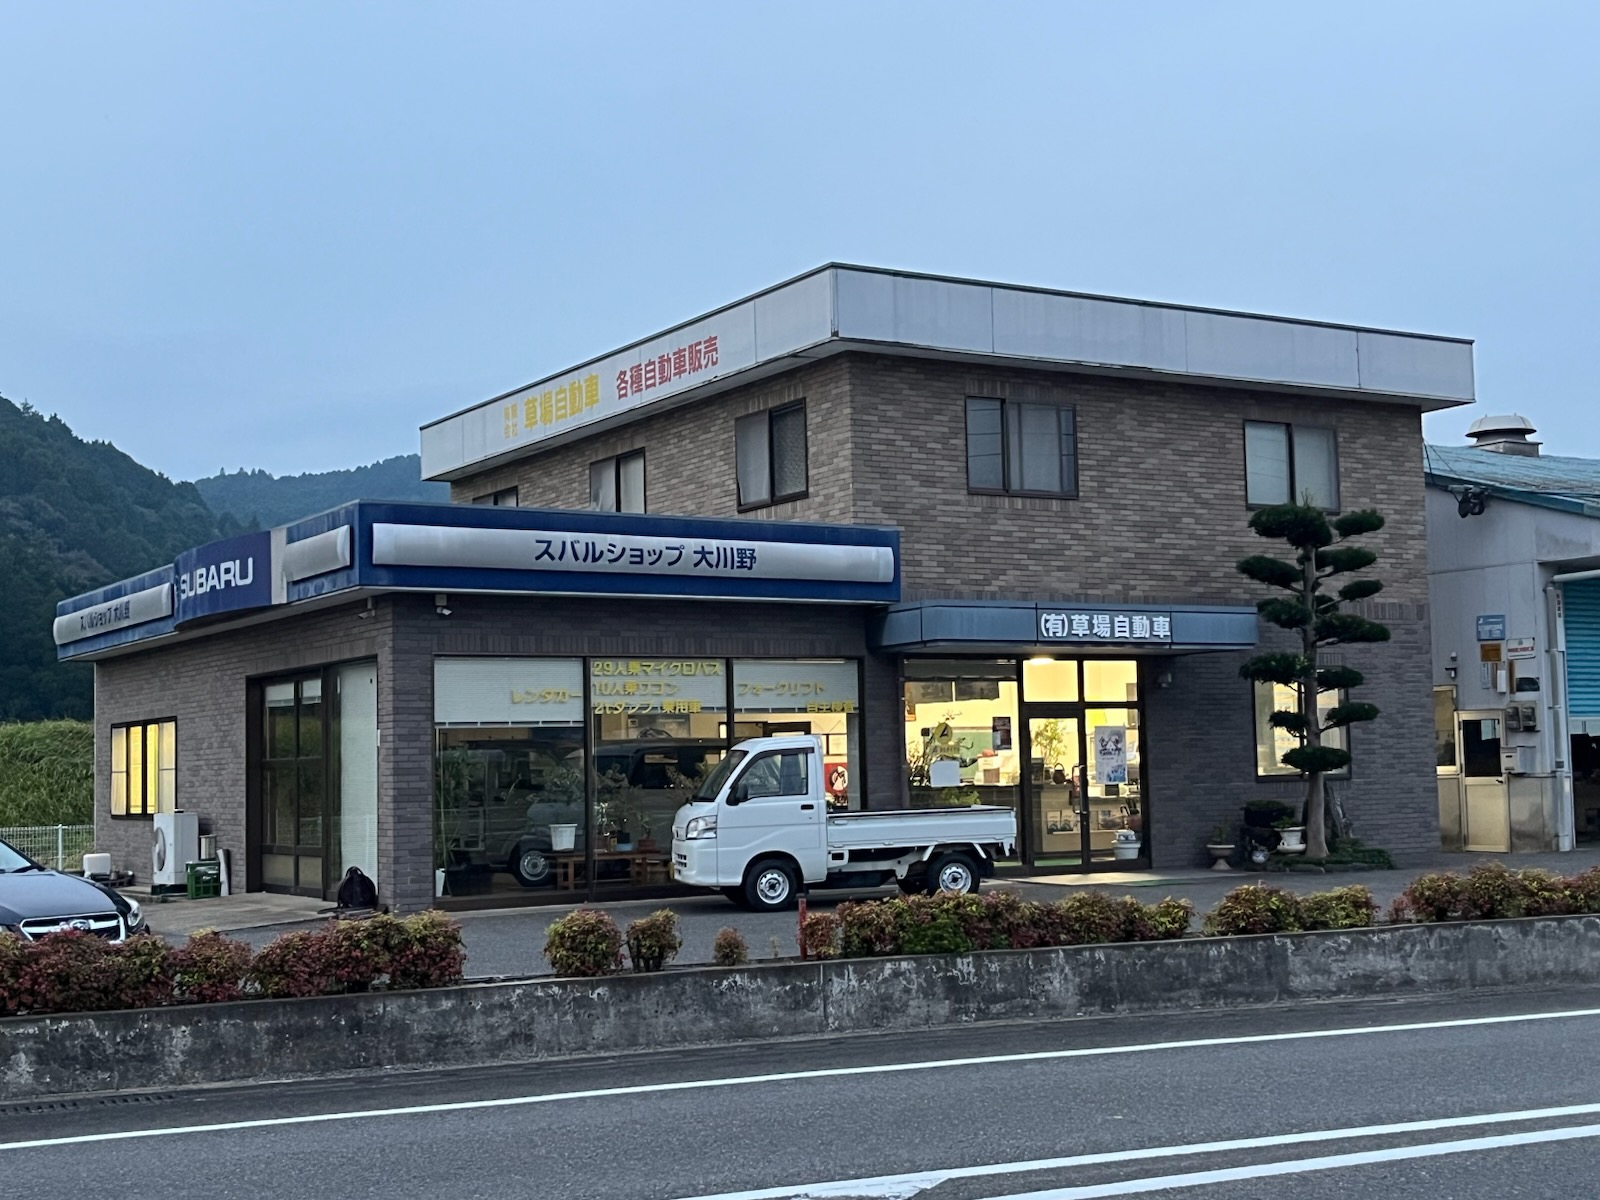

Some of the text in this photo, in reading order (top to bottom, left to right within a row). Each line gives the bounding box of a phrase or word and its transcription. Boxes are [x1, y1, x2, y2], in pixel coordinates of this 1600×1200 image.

[616, 335, 719, 400] 各種自動車販売
[524, 373, 599, 430] 草場自動車
[534, 539, 757, 571] スバルショップ 大川野
[180, 557, 253, 600] SUBARU
[511, 687, 583, 704] レンタカー
